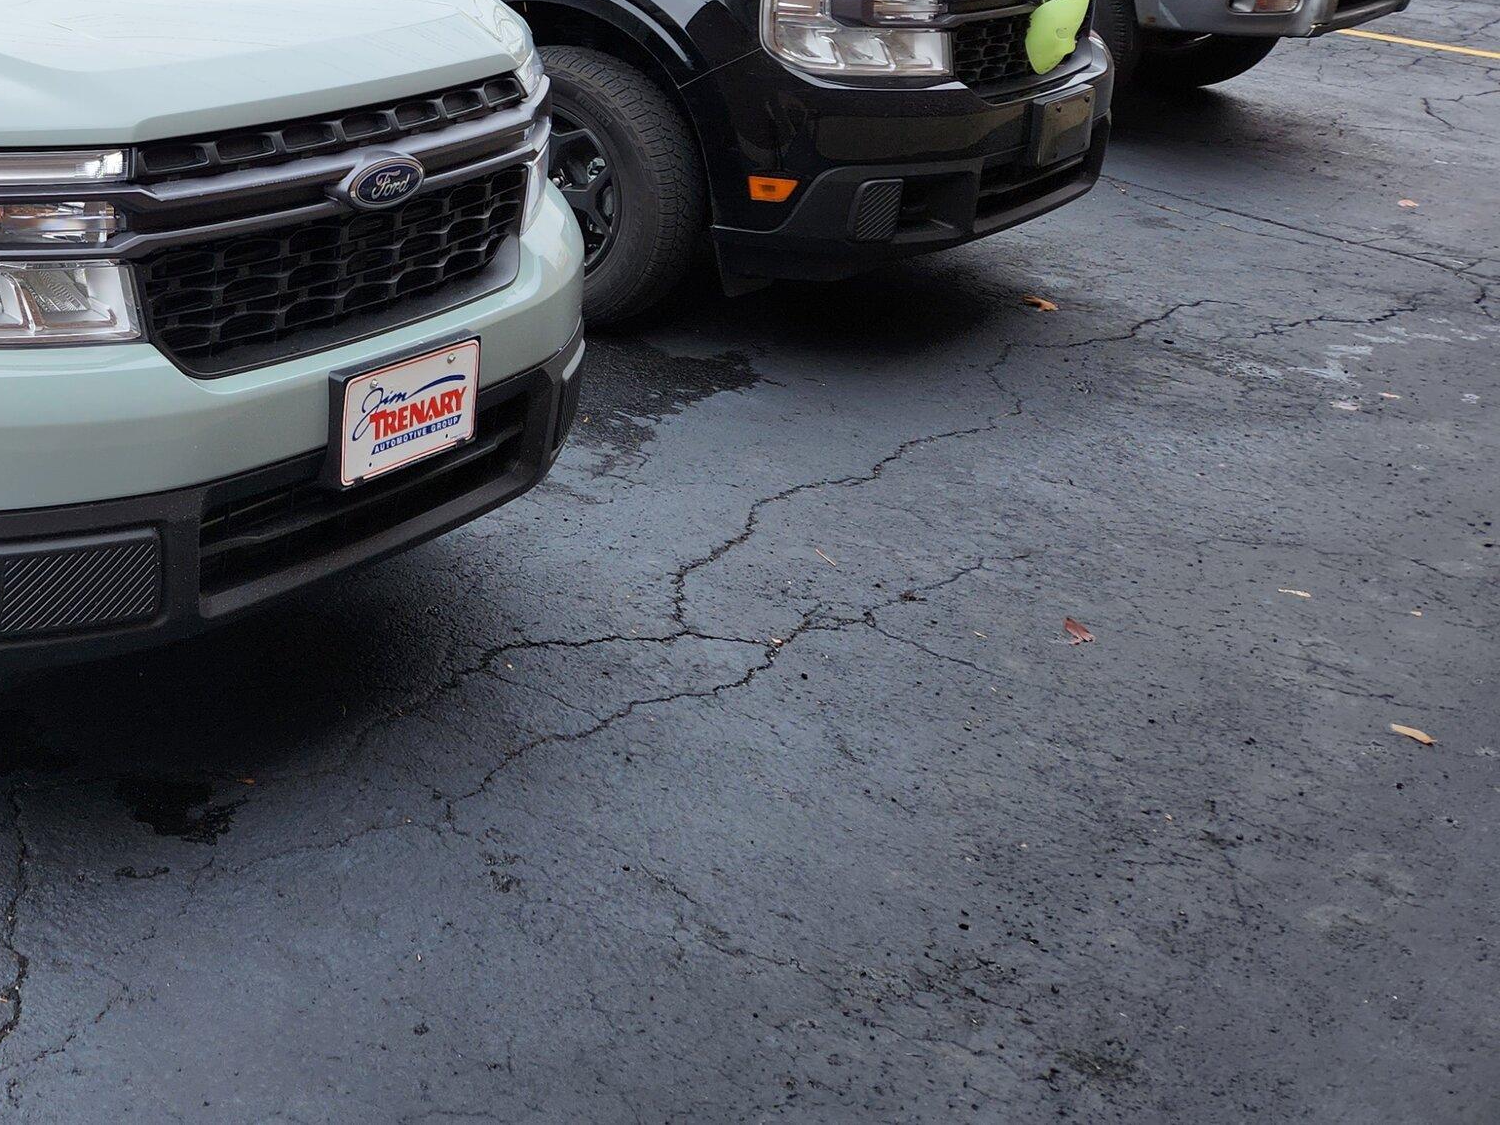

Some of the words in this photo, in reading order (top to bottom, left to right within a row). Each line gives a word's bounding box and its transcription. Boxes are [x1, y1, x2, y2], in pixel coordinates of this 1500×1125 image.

[371, 169, 411, 200] Ford
[352, 386, 409, 441] Jim
[369, 386, 467, 441] TRENARY
[373, 427, 427, 454] AUTOMOTIVE
[430, 416, 459, 433] GROUP
